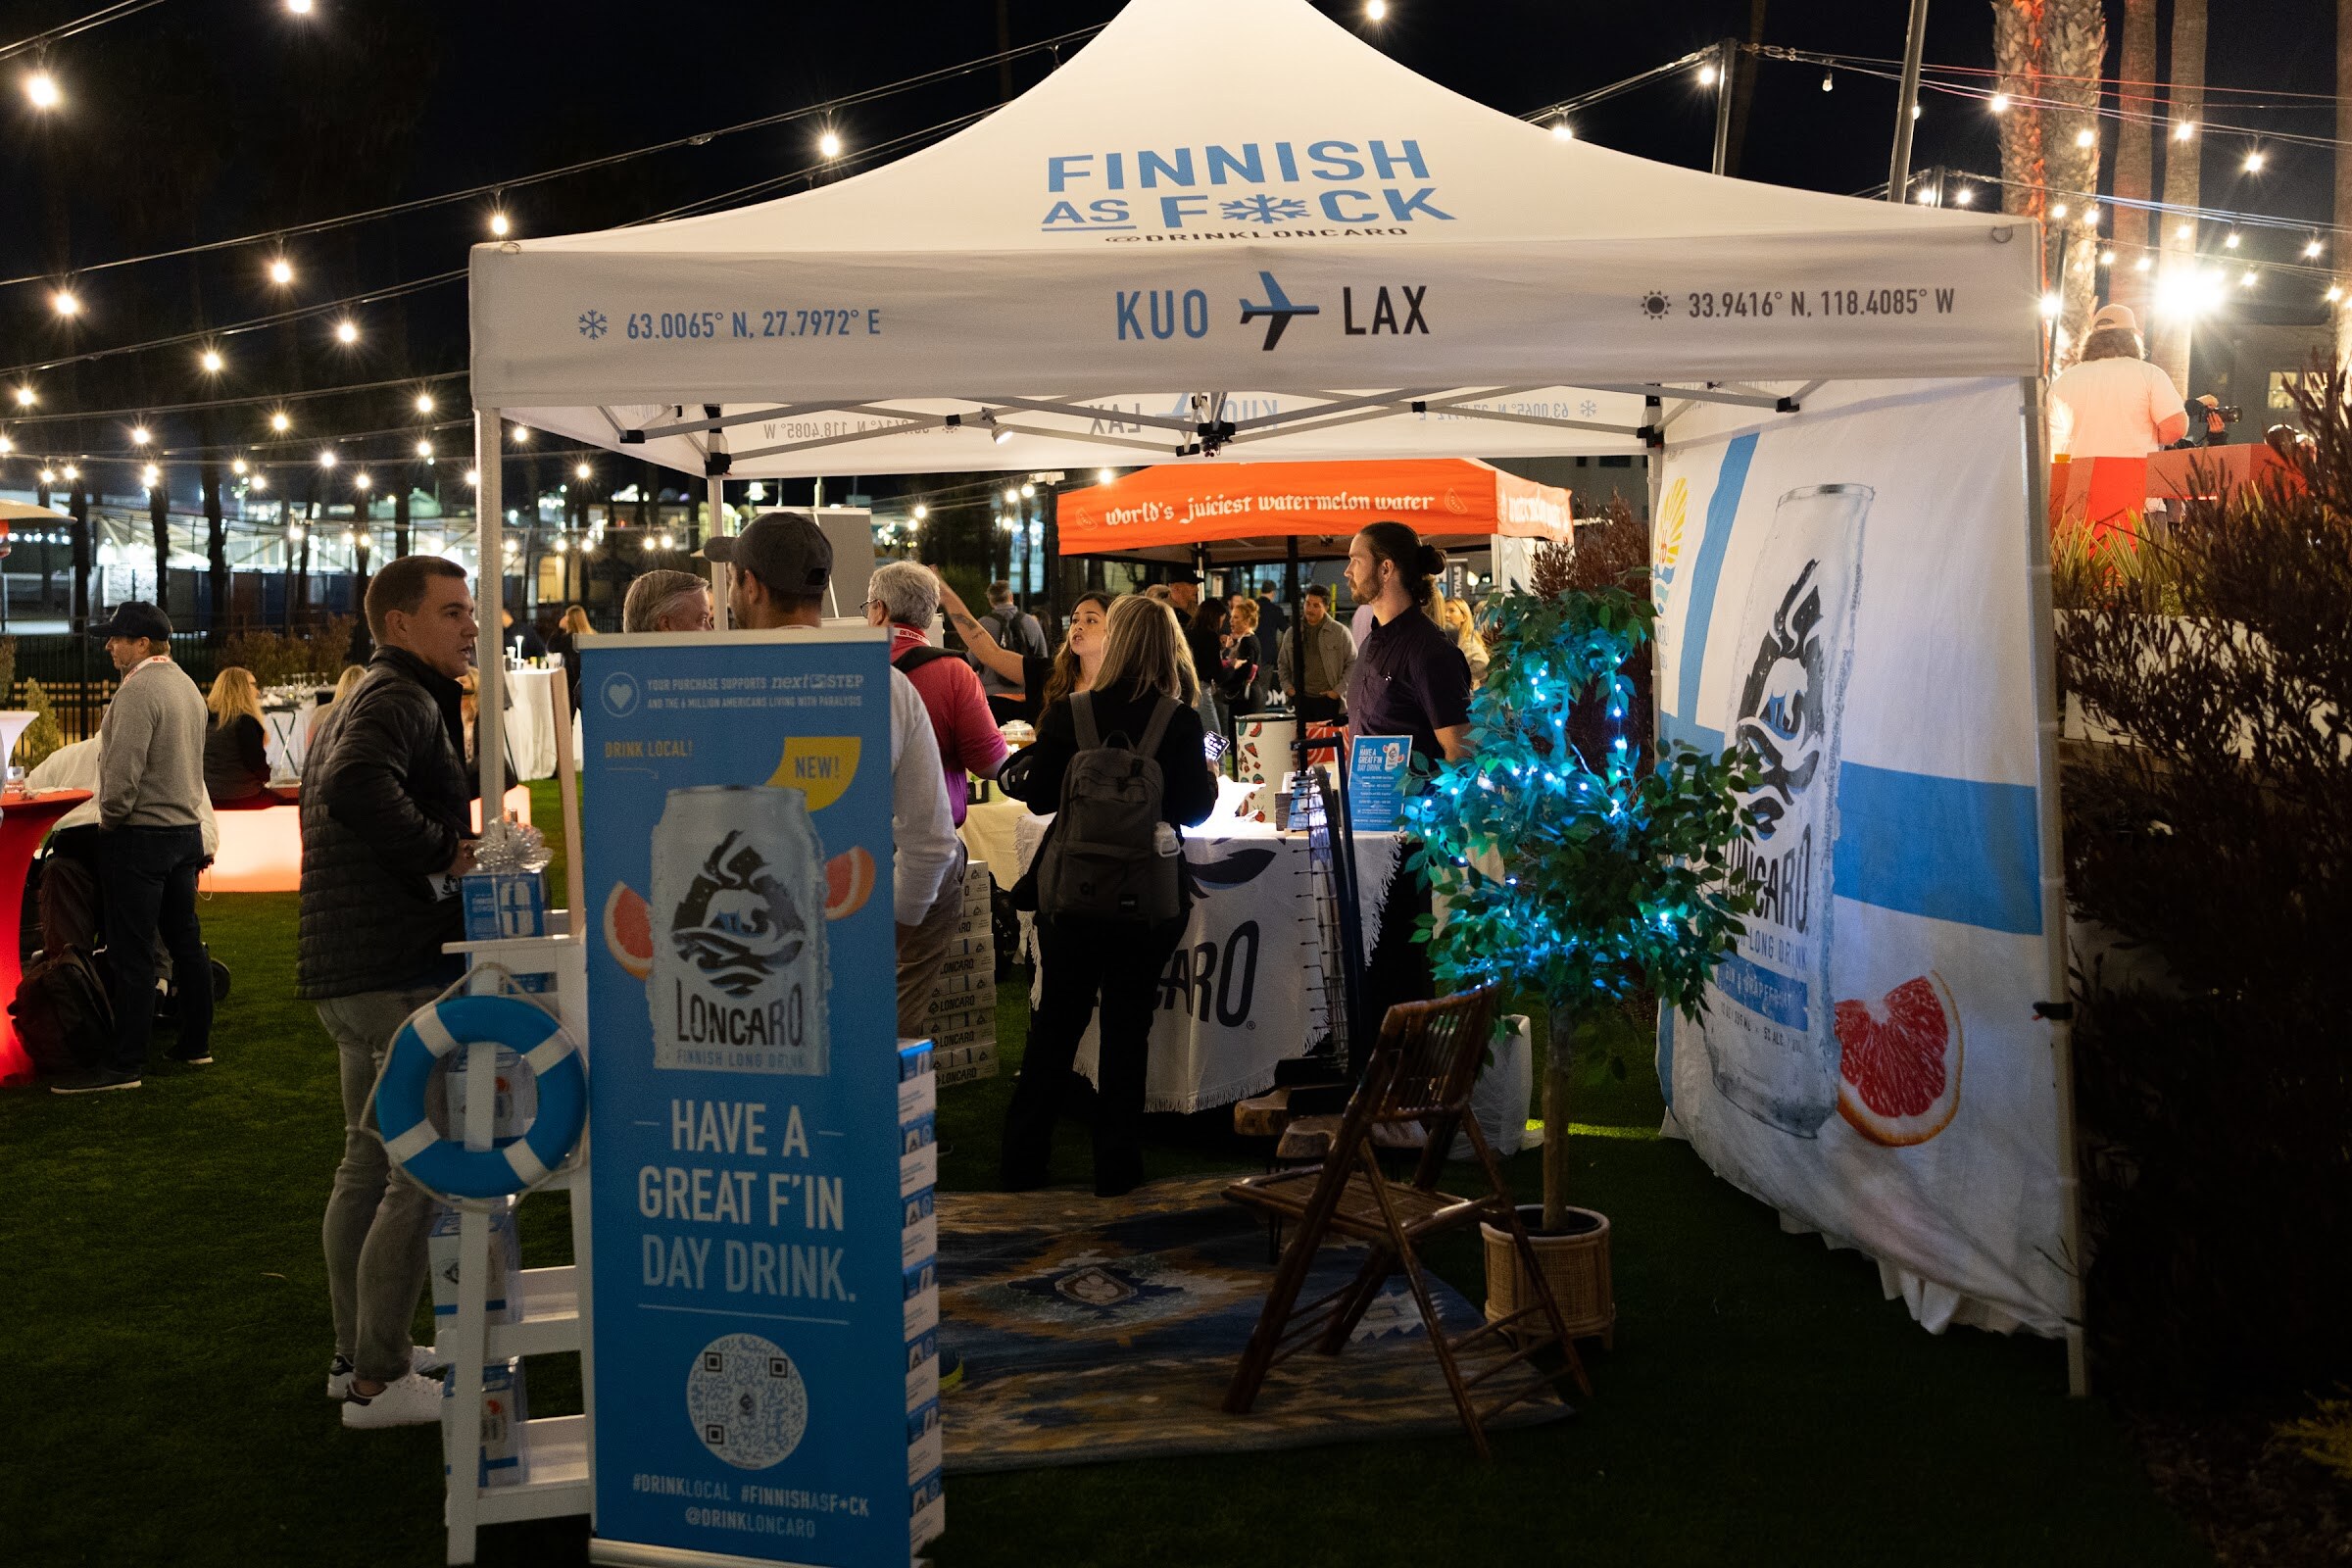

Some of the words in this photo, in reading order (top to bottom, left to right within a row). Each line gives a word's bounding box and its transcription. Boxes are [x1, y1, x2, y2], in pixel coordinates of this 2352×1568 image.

[1048, 139, 1431, 192] FINNISH
[1042, 199, 1130, 224] AS
[1105, 226, 1408, 242] @DRINKLONCARO
[1116, 289, 1208, 340] KUO
[1343, 285, 1430, 335] LAX
[1689, 291, 1783, 318] 33.9416°
[1790, 291, 1812, 318] N,
[1820, 288, 1928, 316] 118.4085°
[1936, 288, 1954, 314] W
[626, 313, 723, 339] 63.0065°
[732, 312, 755, 339] N,
[762, 309, 859, 336] 27.7972°
[868, 309, 881, 335] E
[1179, 494, 1251, 524] juiciest
[1257, 491, 1371, 512] watermelon
[1375, 492, 1435, 512] water
[647, 678, 670, 691] YOUR
[672, 677, 718, 690] PURCHASE
[720, 676, 766, 690] SUPPORTS
[648, 698, 662, 709] AND
[664, 698, 679, 709] THE
[721, 696, 766, 708] AMERICANS
[768, 696, 796, 708] LIVING
[798, 696, 816, 707] WITH
[818, 695, 862, 707] PARALYSIS
[605, 741, 643, 759] DRINK
[648, 740, 694, 758] LOCAL!
[795, 756, 840, 779] NEW!
[1749, 927, 1774, 959] LONG
[1779, 939, 1807, 971] DRINK
[1152, 920, 1260, 1027] ARO
[676, 977, 804, 1047] LONCARO
[940, 995, 974, 1011] LONCARO
[940, 1031, 974, 1048] LONCARO
[676, 1050, 722, 1067] FINNISH
[728, 1052, 762, 1068] LONG
[768, 1052, 805, 1069] DRINK
[941, 1067, 976, 1085] LONCARO
[671, 1099, 767, 1155] HAVE
[781, 1104, 809, 1158] A
[638, 1165, 758, 1225] GREAT
[768, 1173, 844, 1231] F'IN
[642, 1234, 711, 1291] DAY
[724, 1240, 857, 1302] DRINK.
[632, 1473, 730, 1500] #DRINKLOCAL
[685, 1506, 815, 1539] @DRINKLONCARO
